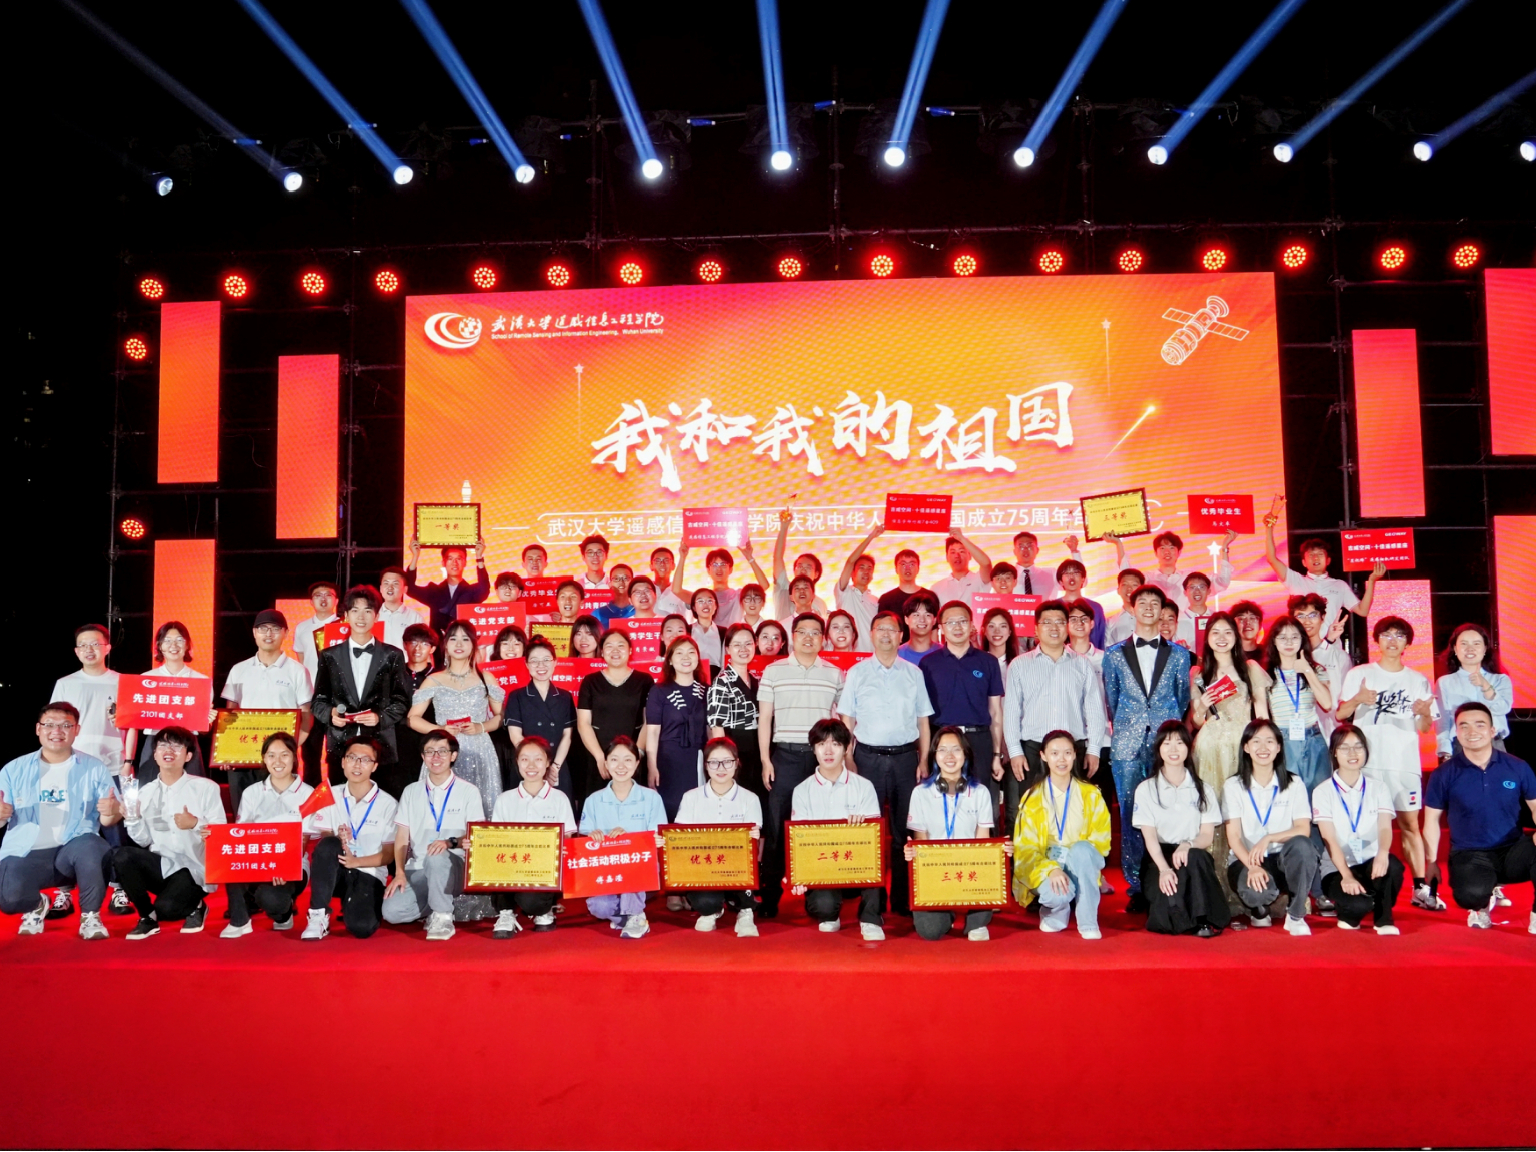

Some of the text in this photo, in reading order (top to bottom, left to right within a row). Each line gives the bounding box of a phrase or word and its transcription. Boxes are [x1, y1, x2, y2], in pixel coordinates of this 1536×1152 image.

[591, 381, 1074, 492] 我和我的祖国
[1200, 507, 1242, 516] 优秀毕业生
[469, 616, 516, 626] 先进党支部
[132, 693, 196, 706] 先进团支部
[140, 710, 184, 720] 2101团支部
[221, 843, 287, 856] 先进团支部
[817, 849, 854, 862] 二等奖
[496, 852, 532, 864] 优秀奖
[567, 851, 652, 869] 社会活动积极分子
[690, 853, 726, 865] 优秀奖
[230, 862, 277, 871] 2311团支部
[941, 870, 978, 883] 三等奖
